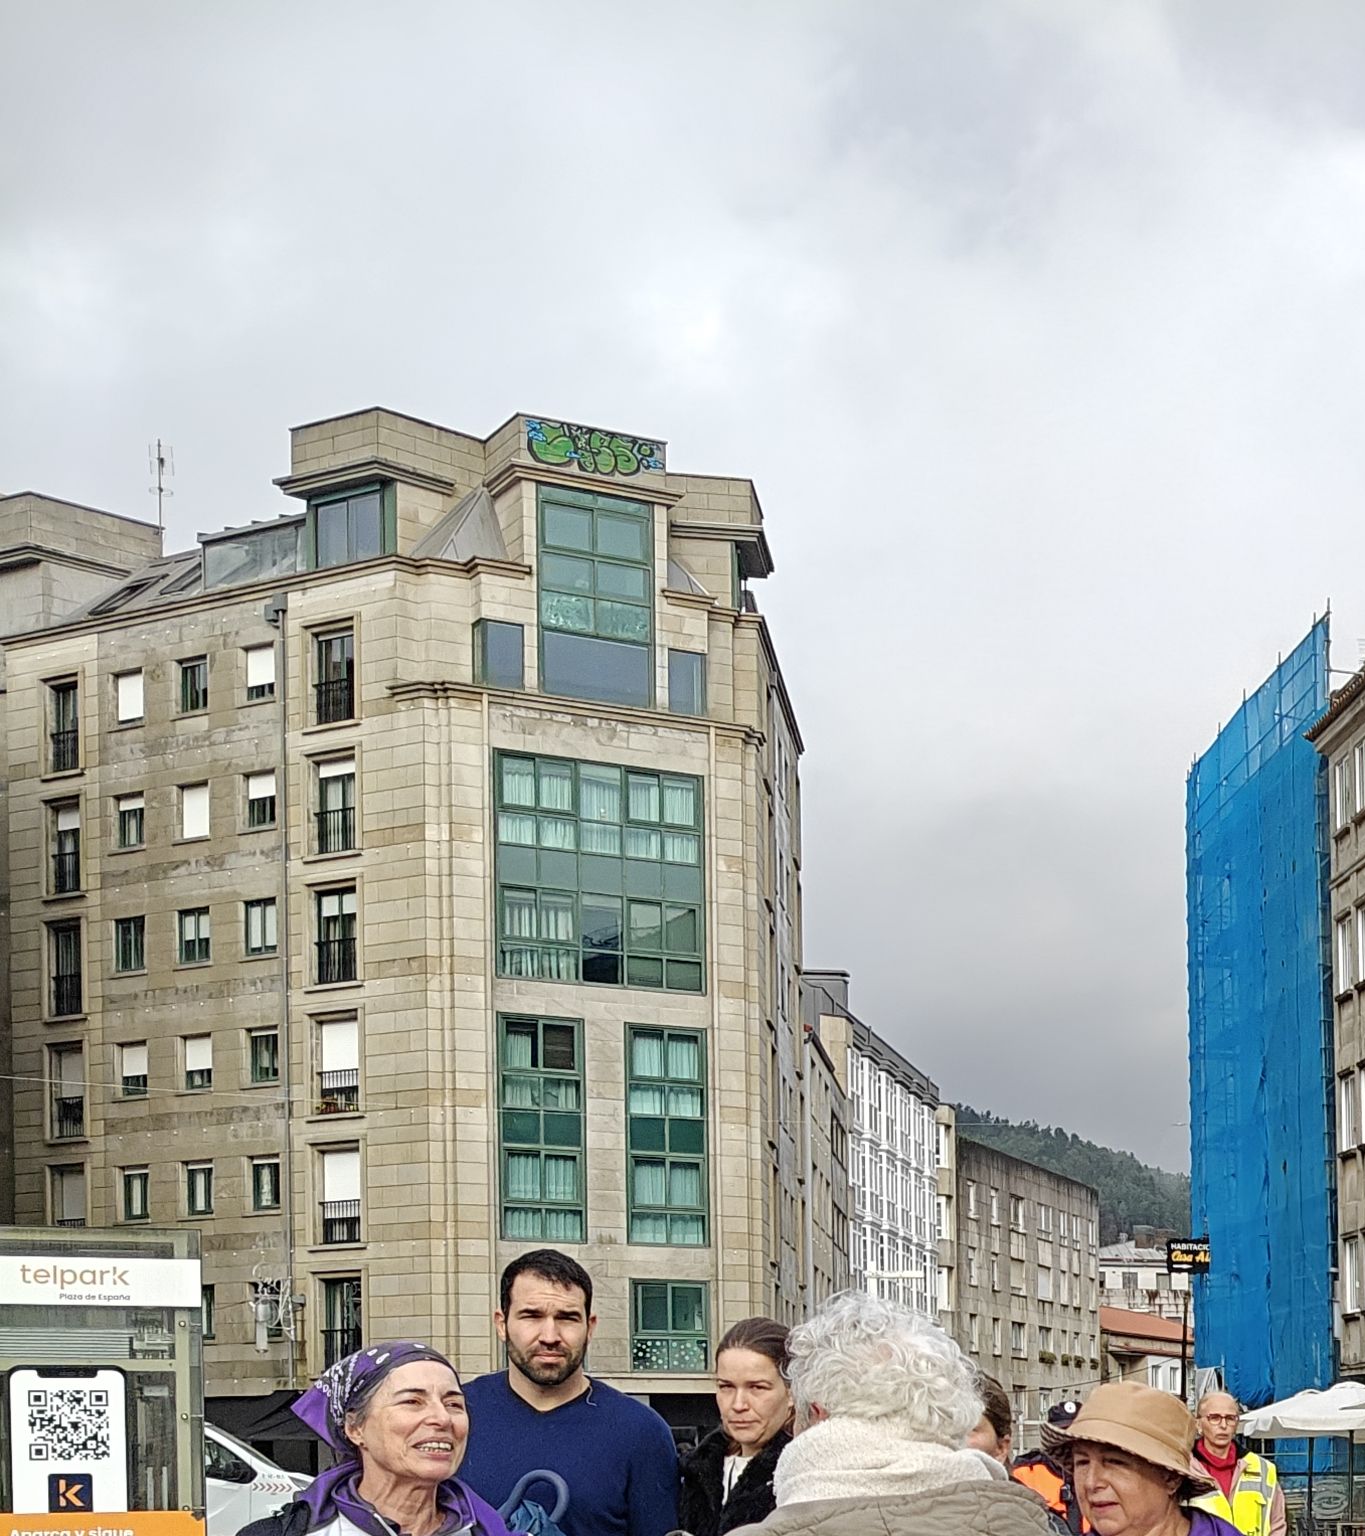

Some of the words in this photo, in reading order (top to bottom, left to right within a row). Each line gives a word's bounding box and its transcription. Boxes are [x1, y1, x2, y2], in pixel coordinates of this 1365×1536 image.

[20, 1264, 130, 1290] telpark
[59, 1293, 83, 1301] Plaza
[85, 1293, 96, 1301] de
[98, 1293, 131, 1302] España
